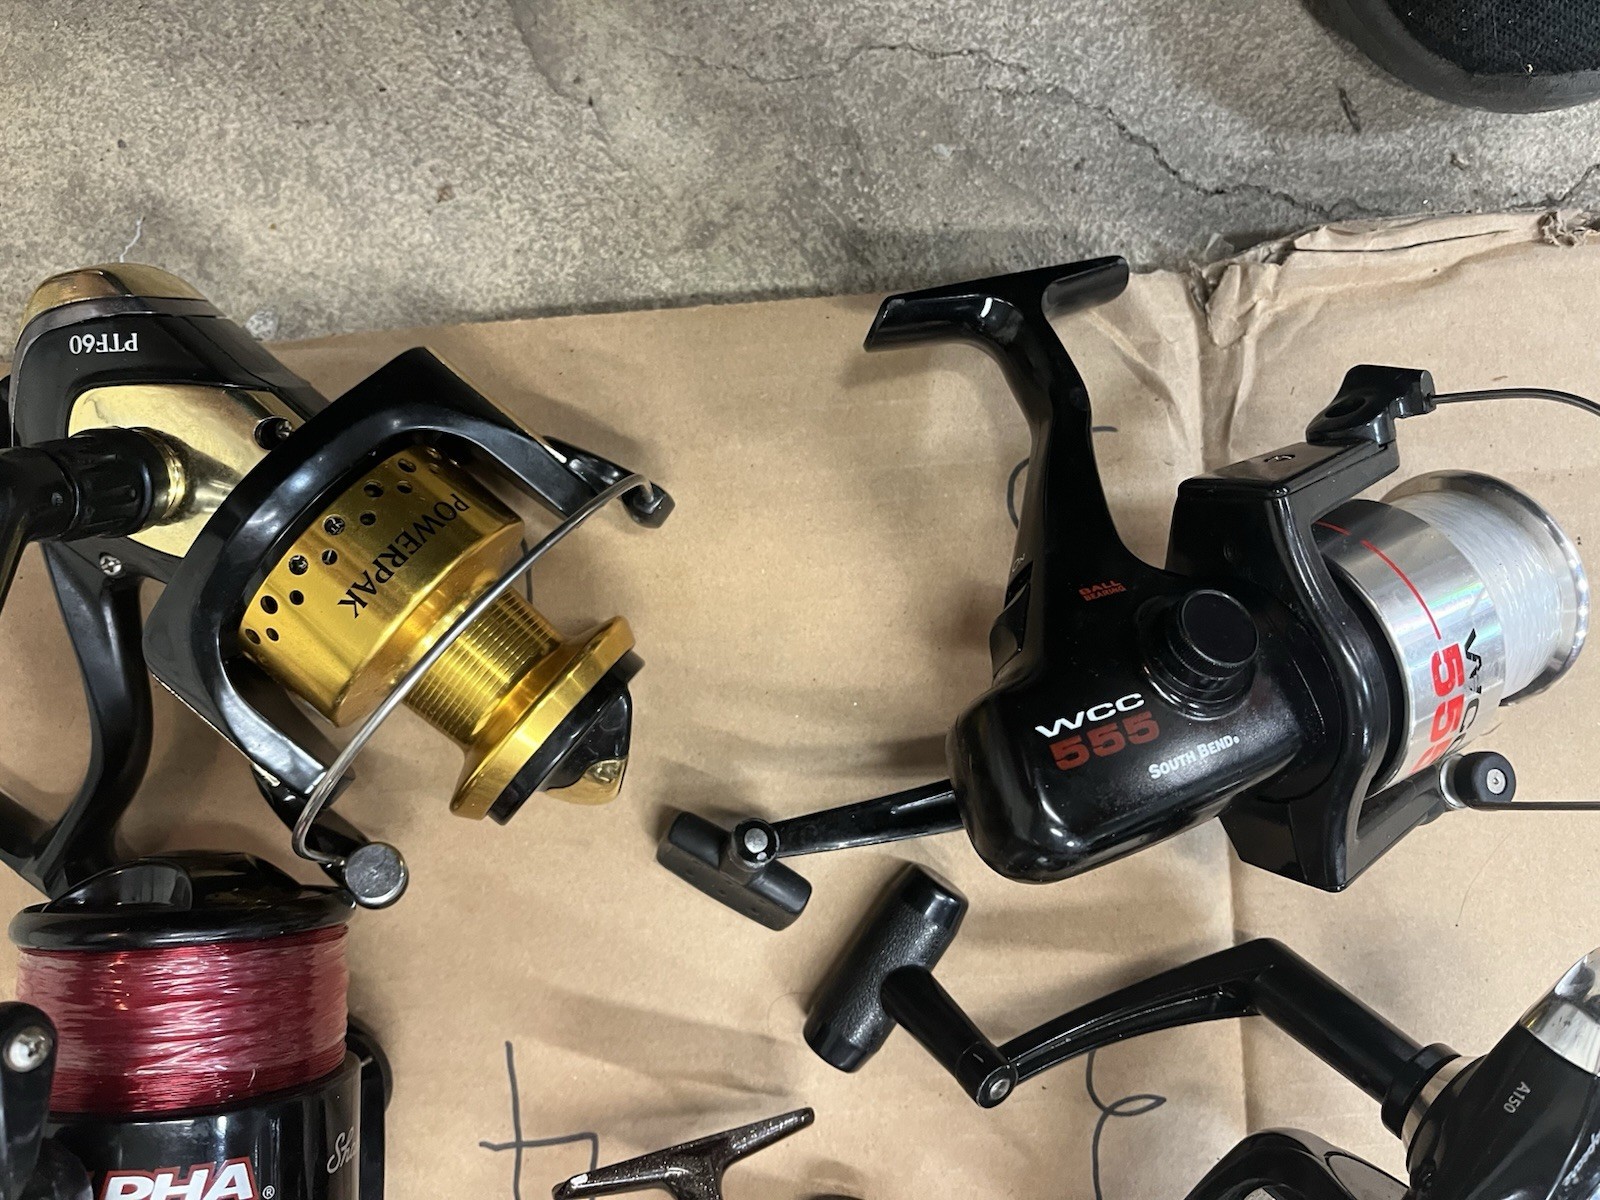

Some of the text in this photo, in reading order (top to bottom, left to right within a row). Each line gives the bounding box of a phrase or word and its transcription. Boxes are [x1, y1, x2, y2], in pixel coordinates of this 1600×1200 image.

[68, 332, 139, 355] PTF60
[337, 493, 471, 619] POWERPAK
[1079, 580, 1122, 596] BALL
[1082, 585, 1128, 601] BEARING
[1035, 692, 1145, 739] WCC
[1050, 711, 1161, 772] 555
[1503, 1081, 1532, 1114] A150
